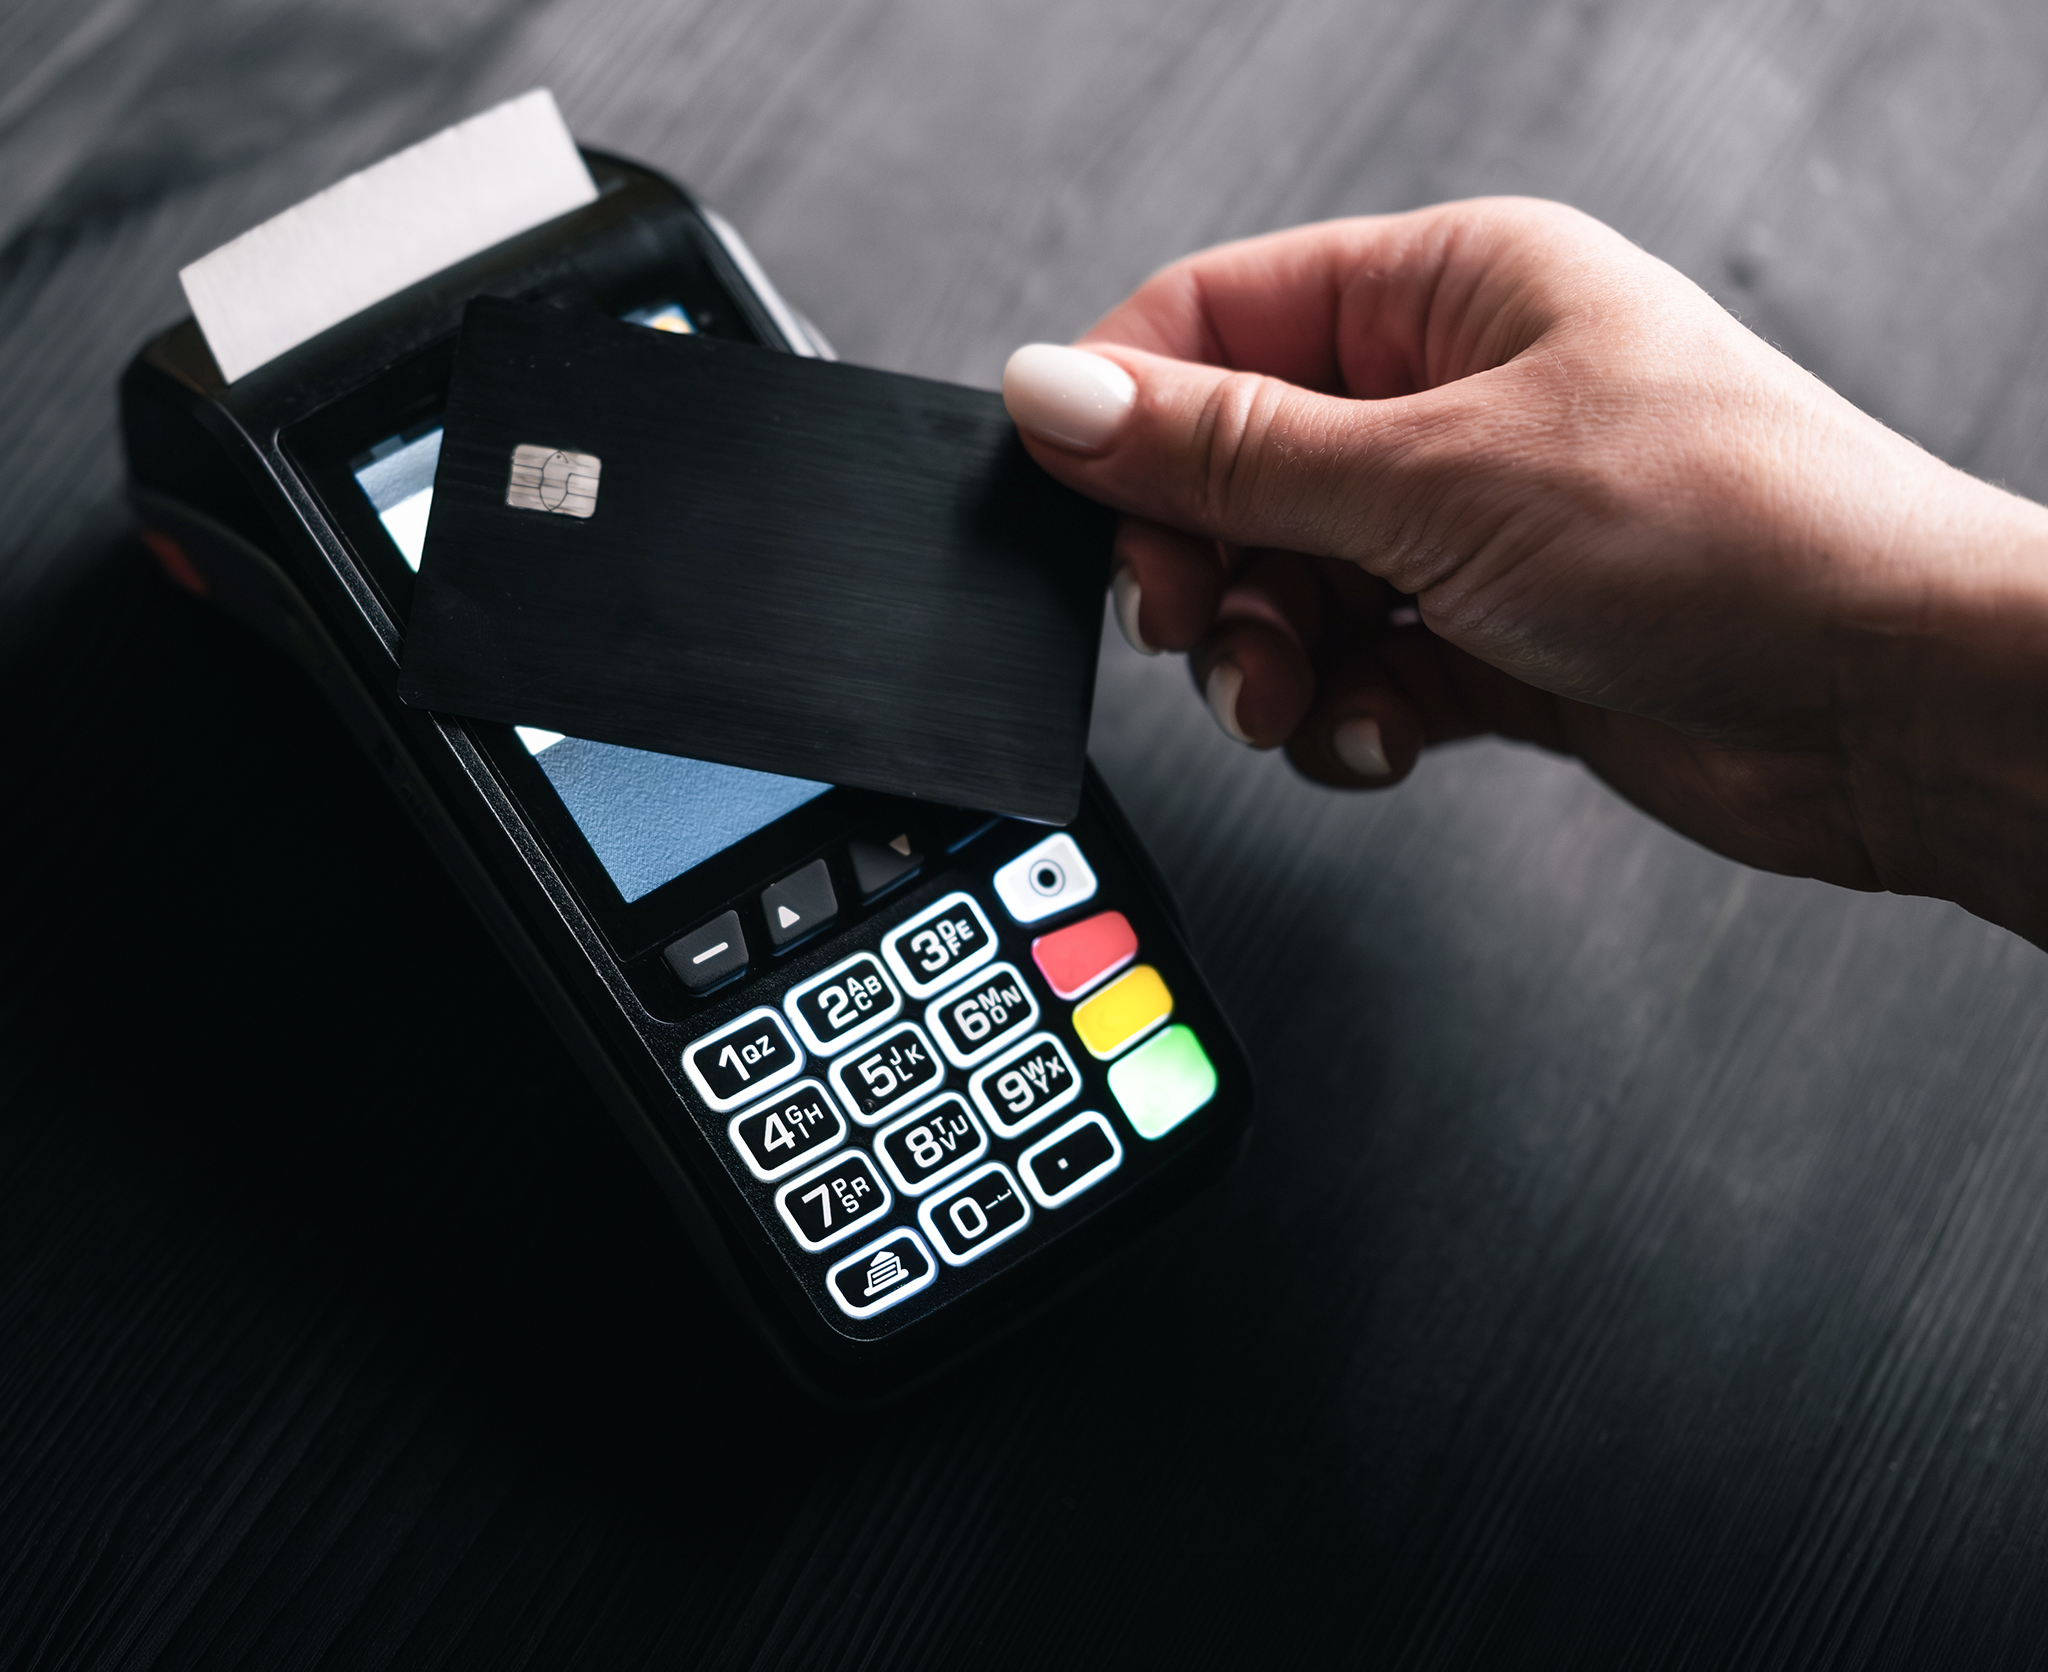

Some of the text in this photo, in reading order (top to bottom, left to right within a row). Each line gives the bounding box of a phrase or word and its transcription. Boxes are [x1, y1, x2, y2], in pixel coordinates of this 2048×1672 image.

[911, 930, 949, 971] 3
[818, 986, 858, 1029] 2
[954, 999, 991, 1040] 6
[719, 1045, 751, 1081] 1
[857, 1054, 898, 1097] 5
[997, 1071, 1034, 1112] 9
[764, 1113, 796, 1153] 4
[905, 1126, 943, 1168] 8
[802, 1184, 833, 1228] 7
